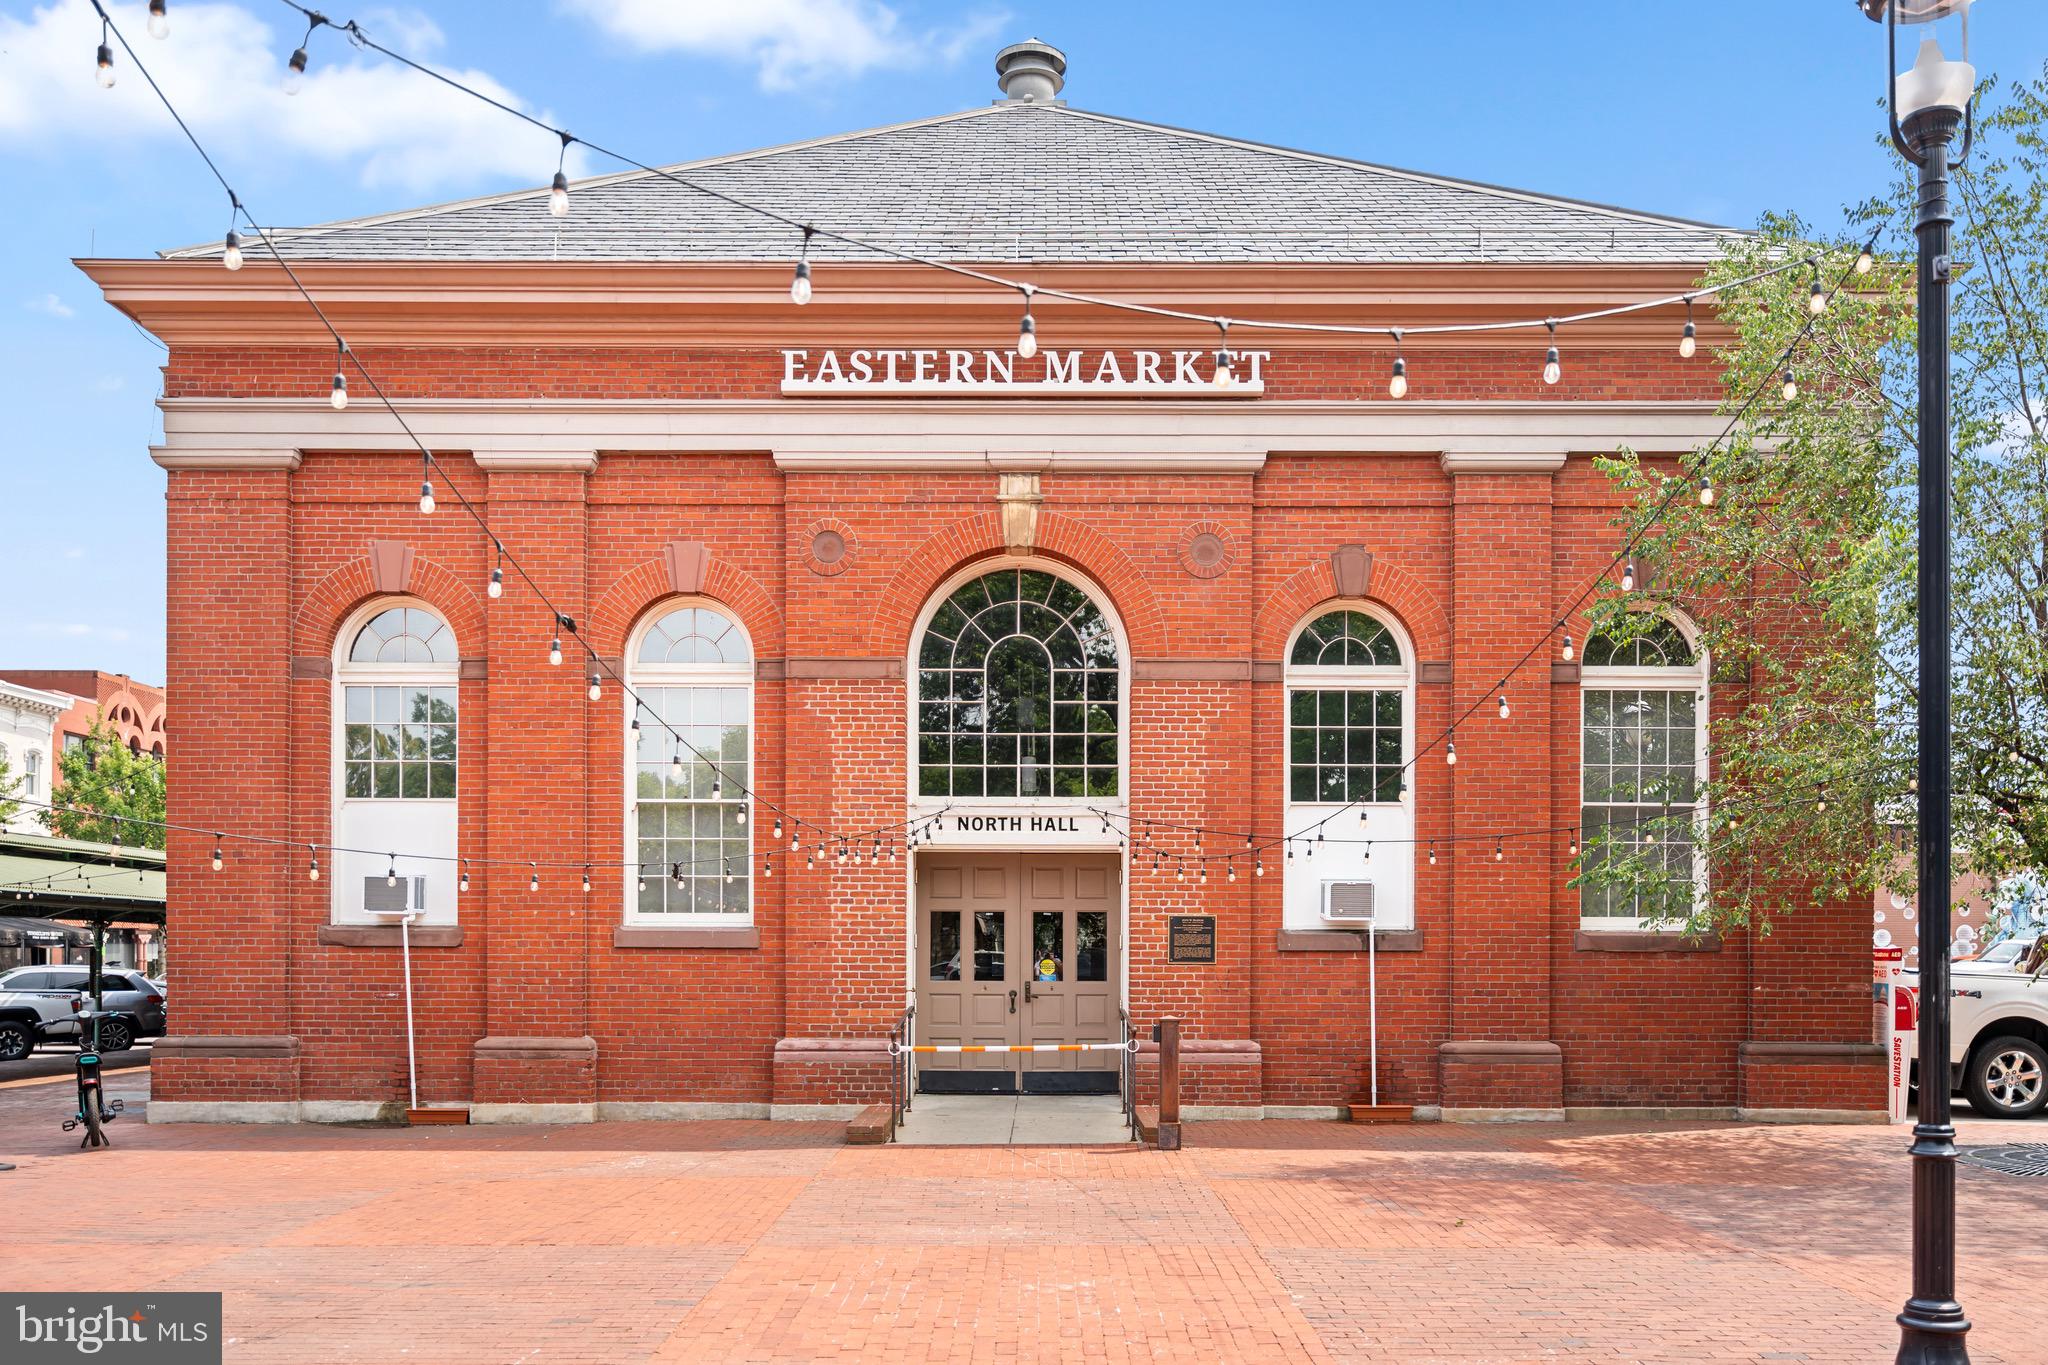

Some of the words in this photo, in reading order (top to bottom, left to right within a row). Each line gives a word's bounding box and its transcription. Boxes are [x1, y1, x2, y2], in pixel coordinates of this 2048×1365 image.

[781, 350, 1014, 383] EASTERN
[1043, 350, 1271, 383] MARKET
[957, 816, 1022, 831] NORTH
[1030, 816, 1079, 831] HALL
